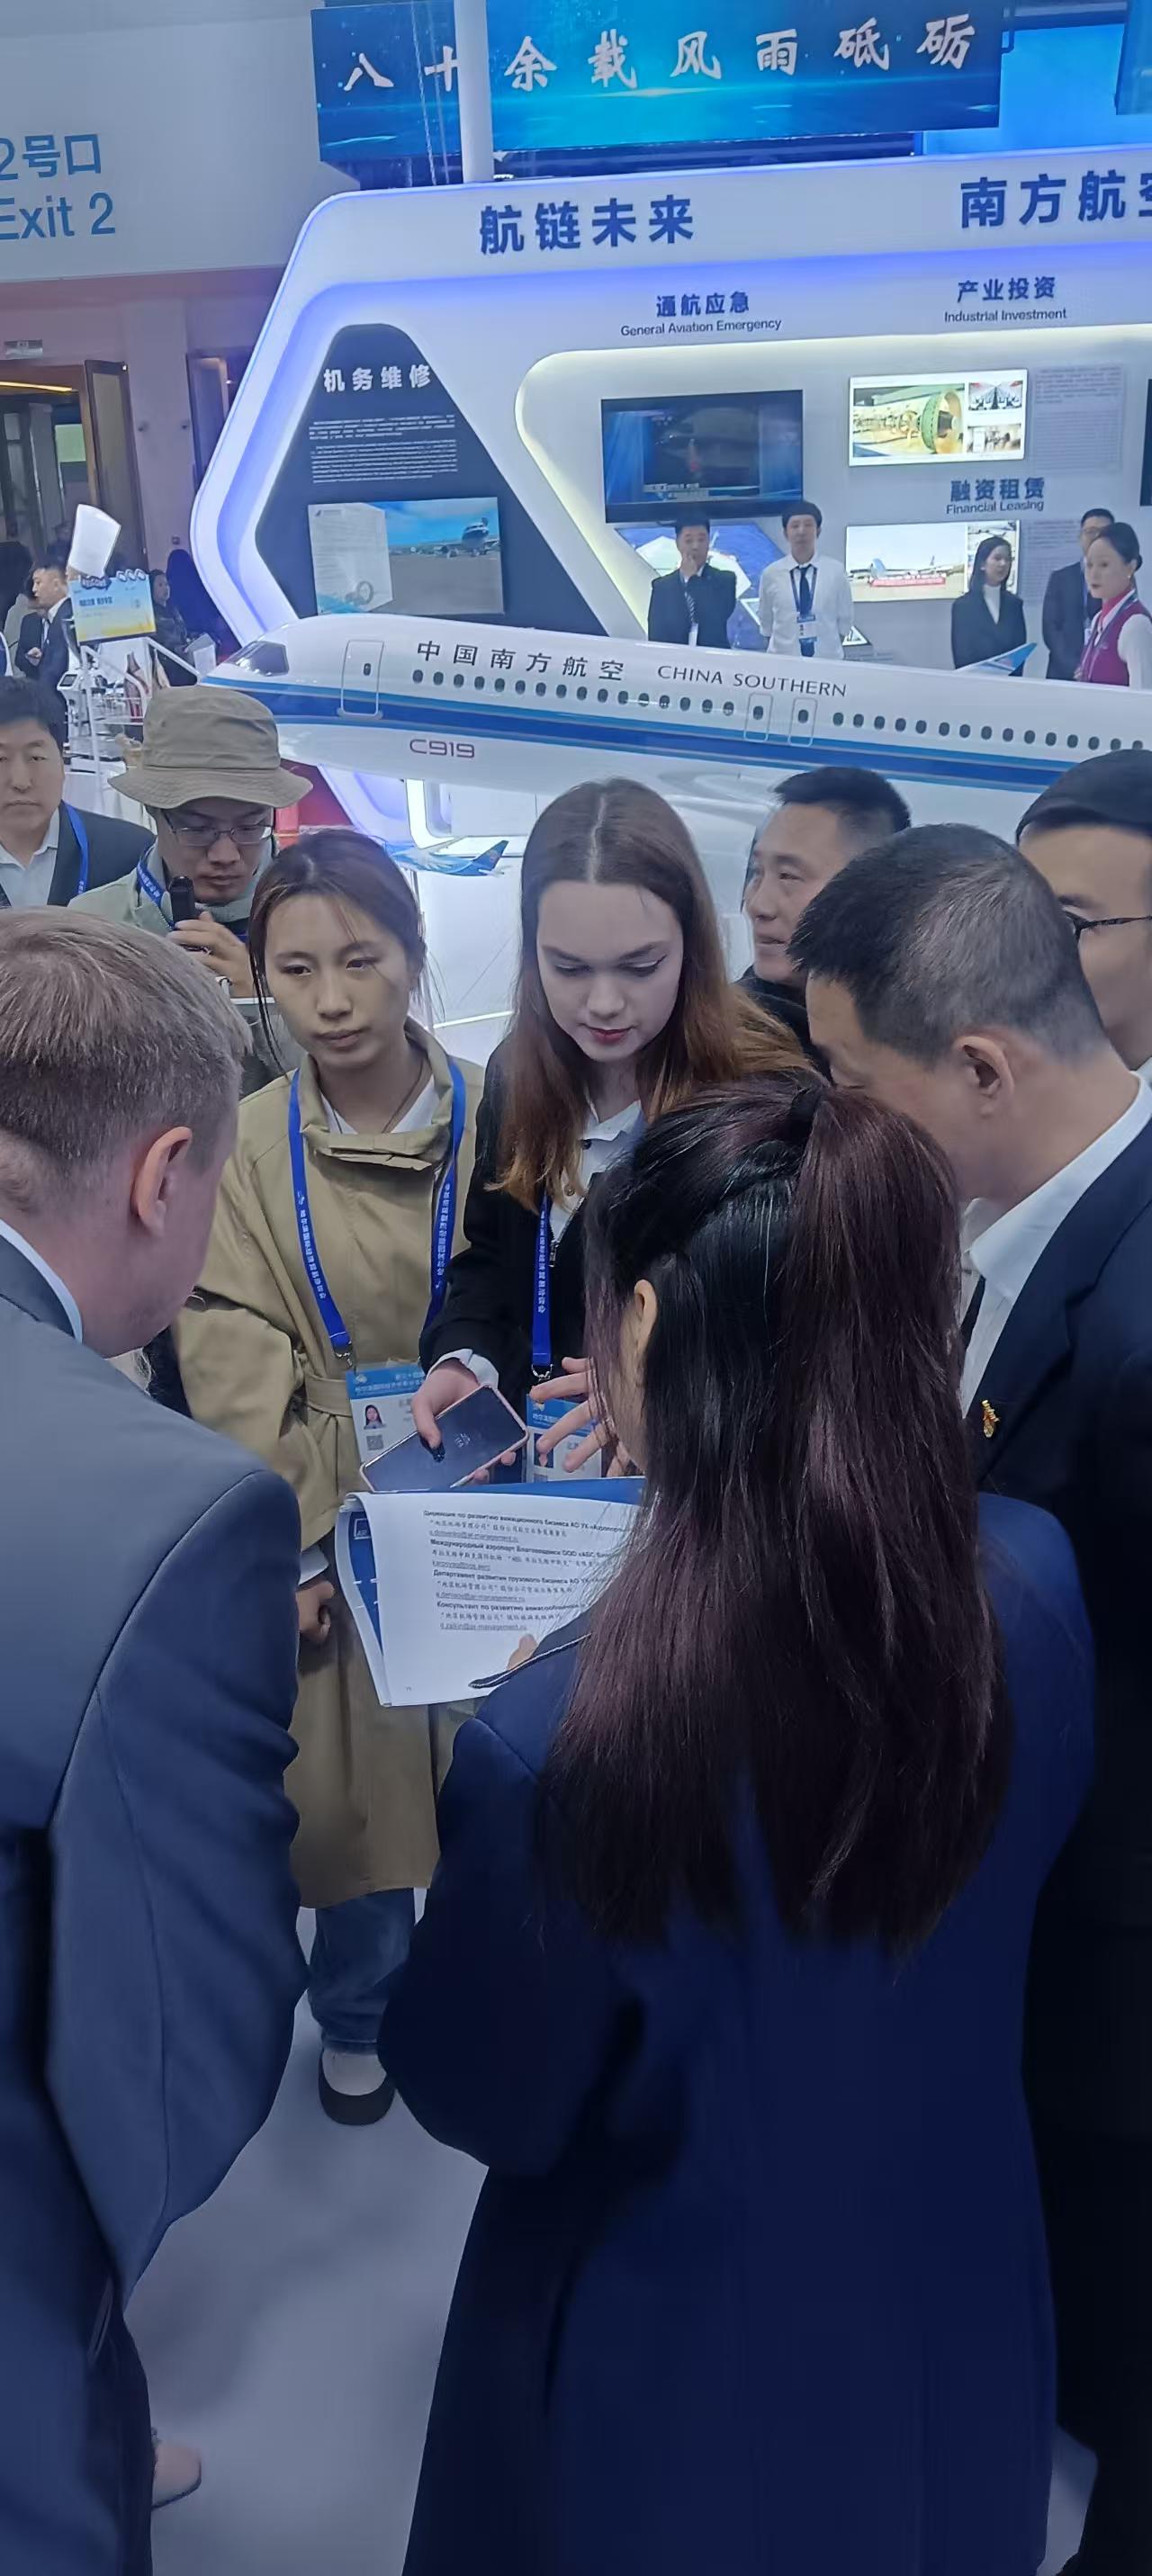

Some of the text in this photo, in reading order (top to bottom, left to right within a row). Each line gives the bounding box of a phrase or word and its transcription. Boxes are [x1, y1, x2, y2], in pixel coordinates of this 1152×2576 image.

[90, 192, 116, 235] 2
[480, 194, 694, 255] 航链未来
[957, 276, 1056, 303] 产业投资
[656, 291, 750, 318] 通航应急
[945, 308, 1067, 323] Industrial Investment
[620, 319, 782, 337] General Aviation Emergency
[324, 364, 431, 392] 机务维修
[950, 477, 1044, 502] 融资租赁
[946, 500, 1044, 515] Financial Leasing
[417, 640, 625, 681] 中国南方航空
[658, 666, 847, 697] CHINA SOUTHERN
[410, 739, 475, 758] C919
